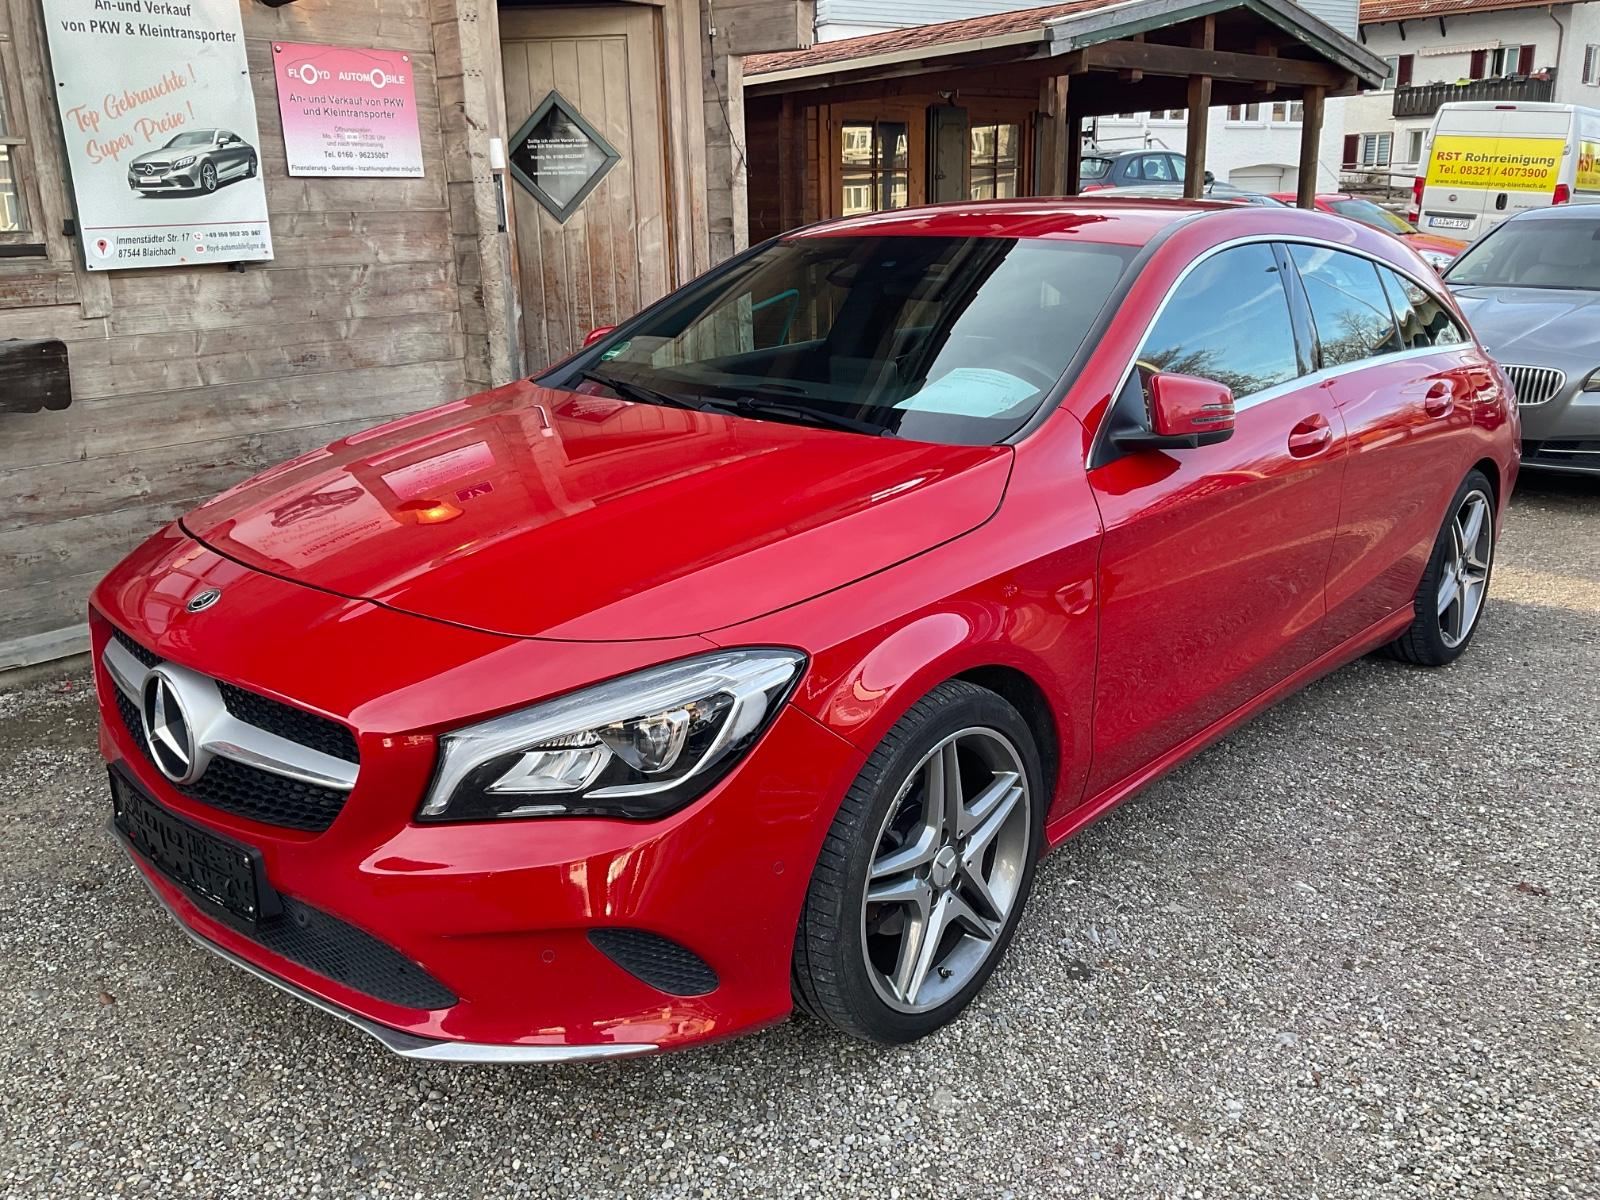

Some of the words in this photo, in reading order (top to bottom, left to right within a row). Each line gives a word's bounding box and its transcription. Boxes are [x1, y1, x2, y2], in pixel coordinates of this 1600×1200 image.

[95, 0, 142, 13] An-und
[145, 0, 192, 17] Verkauf
[61, 20, 86, 32] von
[89, 20, 121, 34] PKW
[125, 22, 136, 35] &
[138, 23, 237, 43] Kleintransporter
[288, 64, 330, 85] FLOYD
[338, 68, 405, 88] AUTOMOBILE
[66, 104, 101, 133] Top
[103, 69, 188, 120] Gebrauchte
[289, 93, 306, 103] An-
[308, 95, 327, 104] und
[329, 96, 363, 106] Verkauf
[365, 98, 381, 106] von
[383, 97, 405, 108] PKW
[303, 107, 321, 116] und
[323, 107, 396, 120] Kleintransporter
[86, 133, 134, 165] Super
[134, 111, 186, 143] Preise
[324, 151, 336, 159] Tel.
[337, 151, 354, 159] 0160
[1436, 151, 1461, 161] RST
[1465, 152, 1555, 167] Rohrreinigung
[1439, 164, 1456, 175] Tel.
[1460, 165, 1491, 176] 08321
[1501, 167, 1548, 179] 4073900
[116, 234, 166, 245] Immenstädter
[167, 233, 180, 243] Str.
[181, 233, 190, 242] 17
[118, 248, 141, 258] 87544
[142, 247, 176, 257] Blaichach
